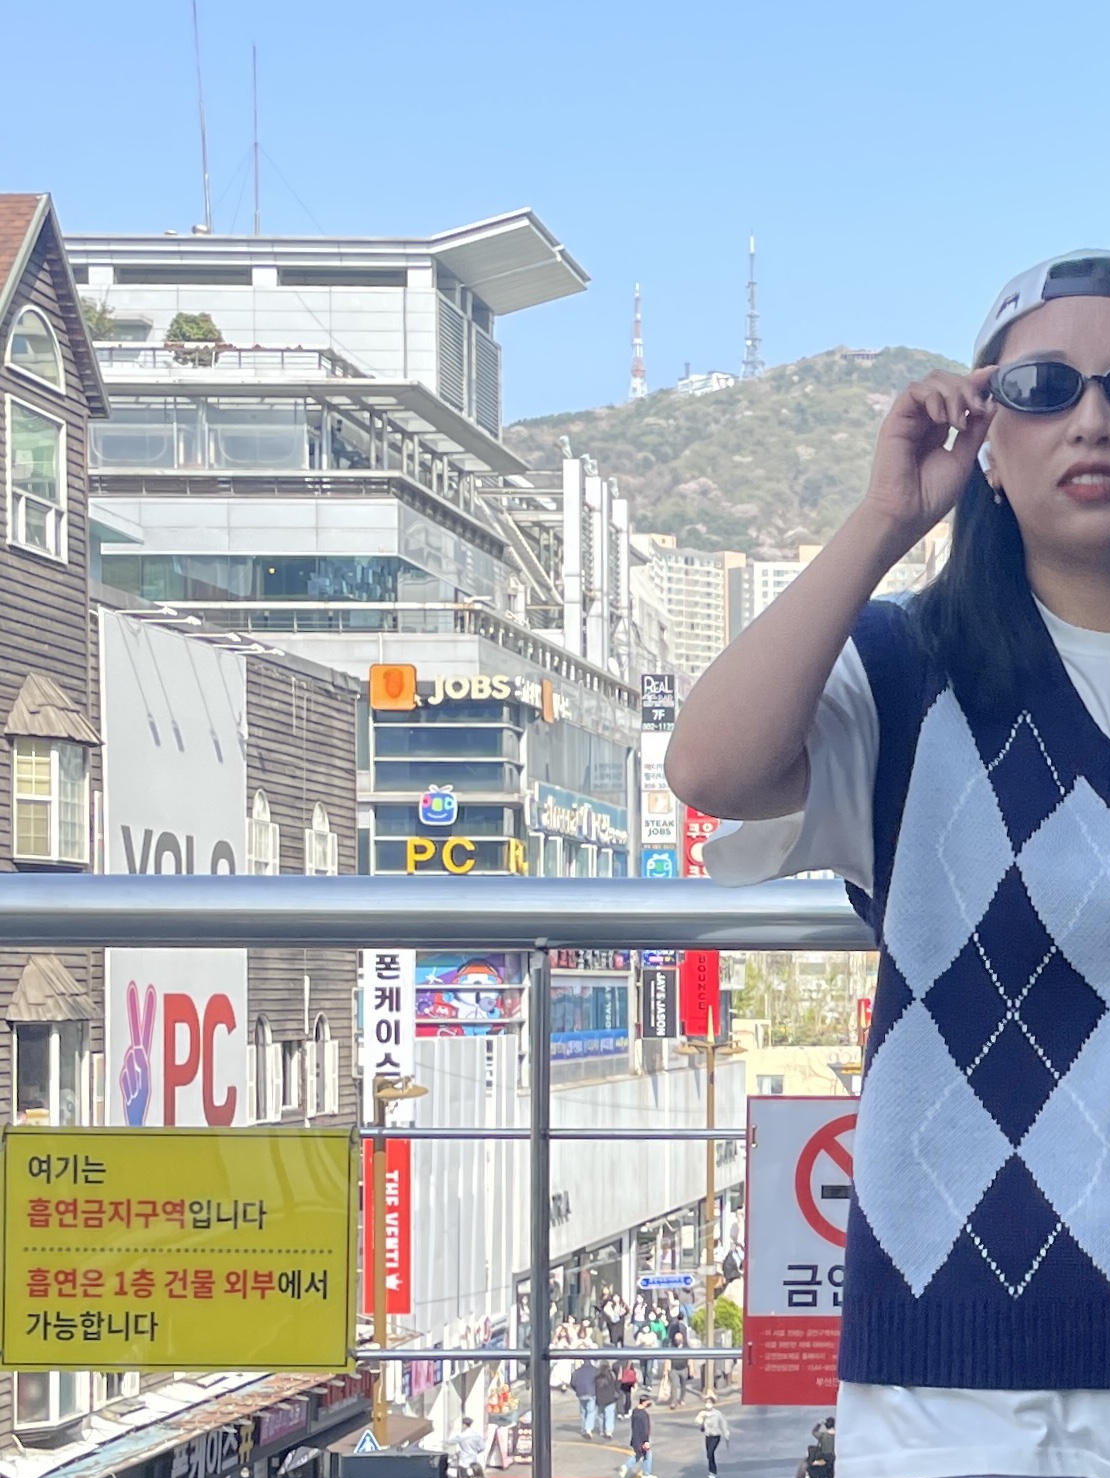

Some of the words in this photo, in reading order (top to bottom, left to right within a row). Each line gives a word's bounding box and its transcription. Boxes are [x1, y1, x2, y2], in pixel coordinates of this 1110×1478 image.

[428, 674, 511, 705] JOBS
[644, 676, 673, 695] REAL
[652, 709, 665, 720] 7F
[645, 819, 674, 827] STEAK
[648, 826, 671, 836] JOBS
[406, 838, 477, 874] PC
[656, 972, 666, 991] JAY
[697, 955, 707, 1010] BOUNCE
[374, 953, 400, 1077] 폰케이스
[163, 992, 237, 1126] PC
[28, 1154, 106, 1185] 여기는
[385, 1170, 399, 1207] THE
[27, 1198, 267, 1230] 흡연금지구역입니다
[385, 1213, 399, 1268] VENTI
[26, 1268, 104, 1299] 흡연은
[113, 1269, 156, 1298] 1층
[164, 1269, 215, 1299] 건물
[224, 1269, 328, 1300] 외부에서
[26, 1312, 158, 1342] 가능합니다
